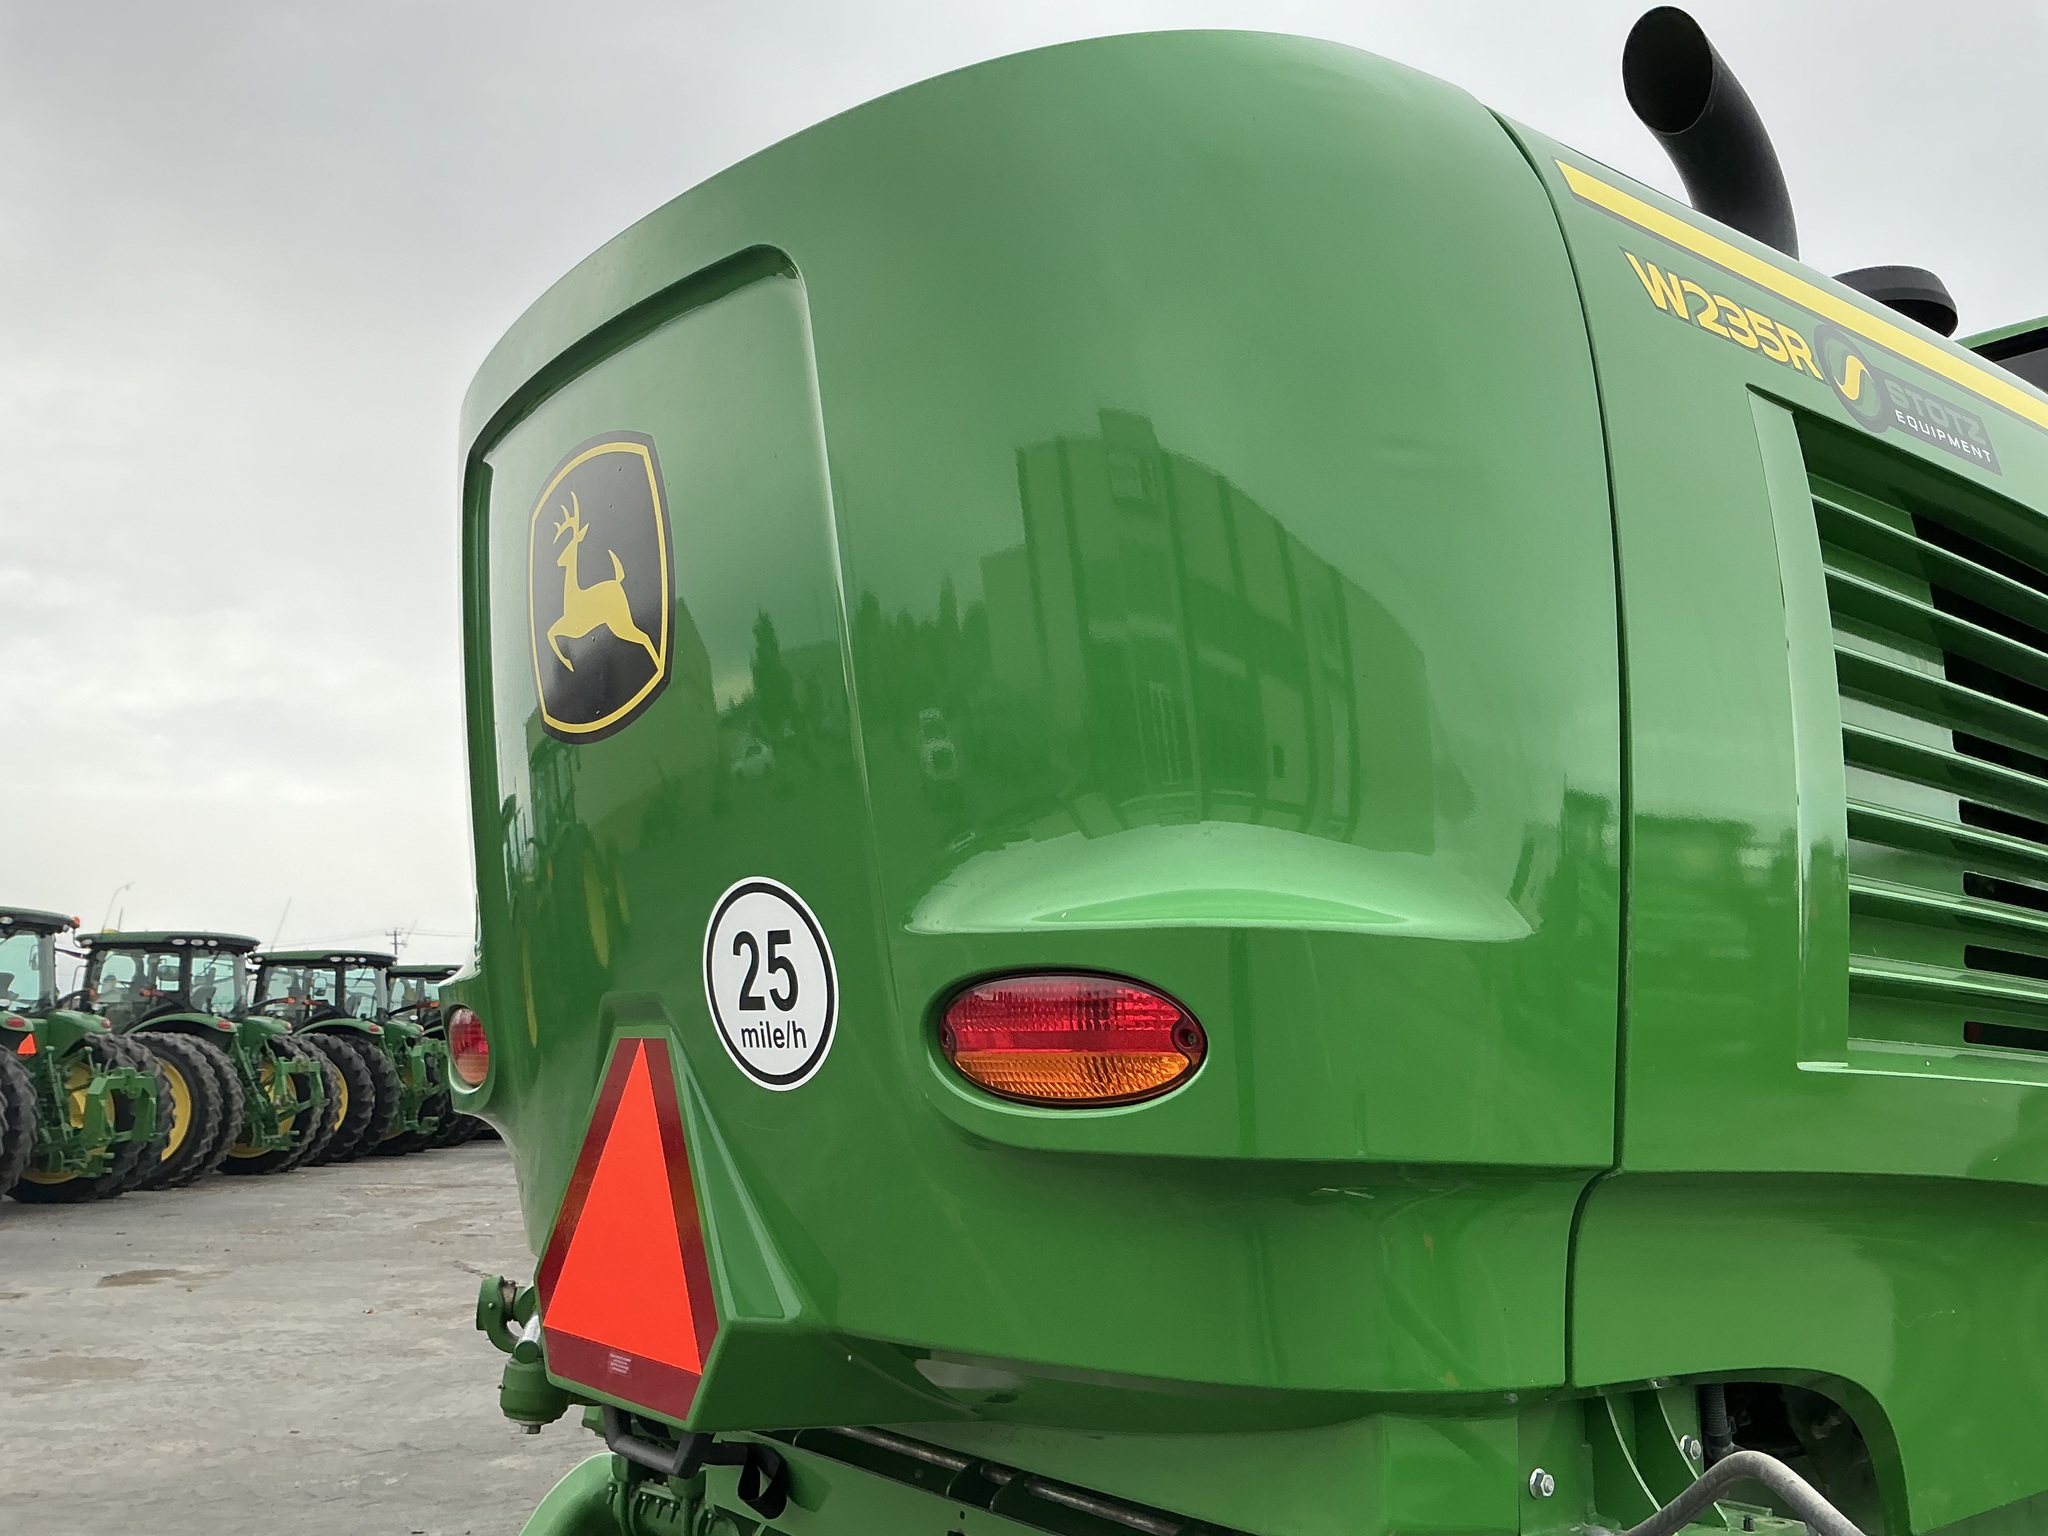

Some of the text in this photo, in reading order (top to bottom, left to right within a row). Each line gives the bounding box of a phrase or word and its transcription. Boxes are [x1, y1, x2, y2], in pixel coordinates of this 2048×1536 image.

[1624, 251, 1823, 380] W235R
[1885, 379, 1986, 445] STOTZ
[1895, 409, 1991, 463] EQUIPMENT
[732, 929, 799, 1012] 25
[741, 1020, 807, 1048] mile/h
